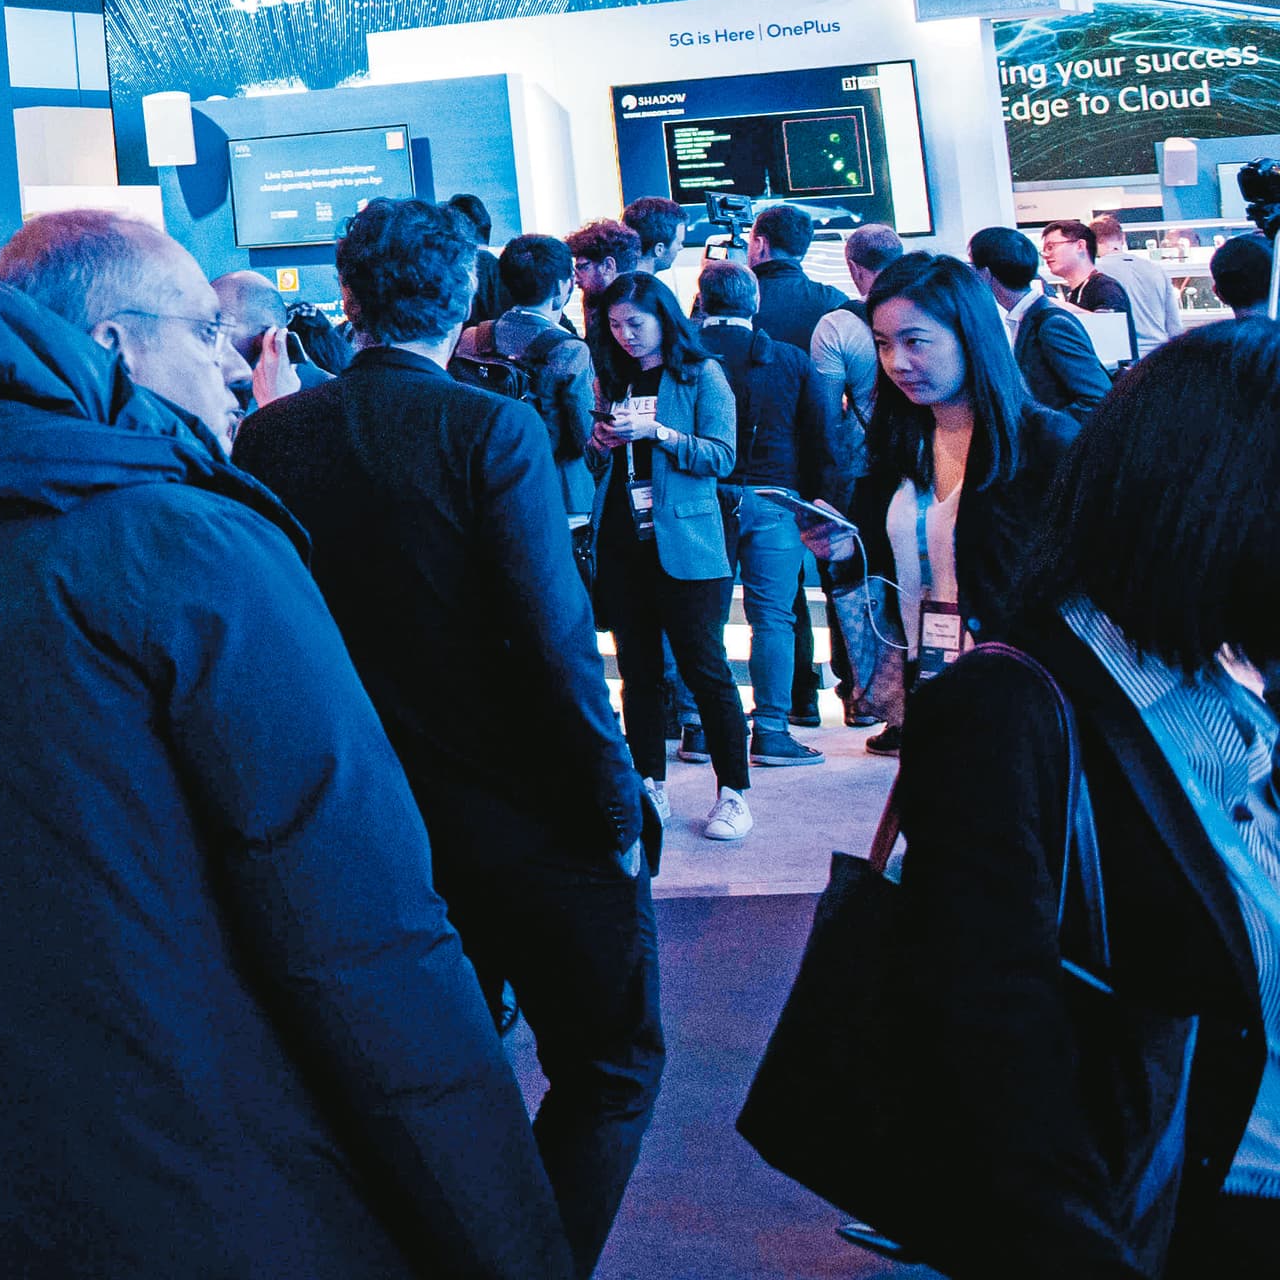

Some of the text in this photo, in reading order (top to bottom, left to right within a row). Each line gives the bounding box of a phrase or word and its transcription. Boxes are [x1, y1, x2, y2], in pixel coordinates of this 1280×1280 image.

[669, 20, 841, 47] 5G is Here OnePlus
[1055, 56, 1125, 86] your
[1135, 46, 1259, 74] success
[638, 93, 686, 106] SHADOW
[1077, 92, 1110, 116] to
[1119, 80, 1211, 112] Cloud
